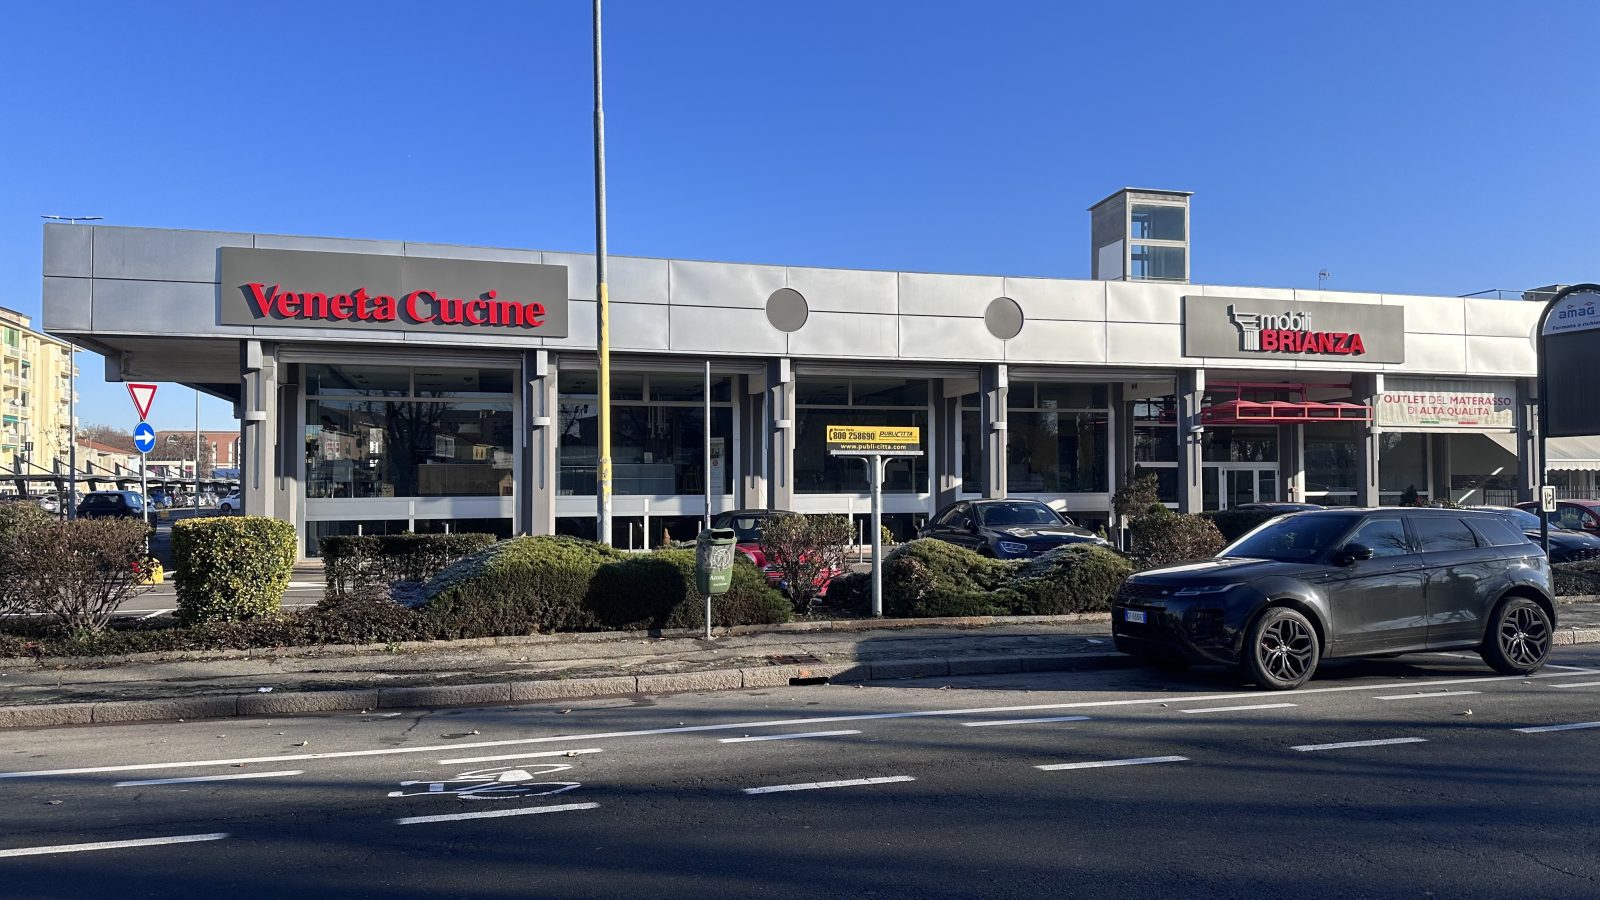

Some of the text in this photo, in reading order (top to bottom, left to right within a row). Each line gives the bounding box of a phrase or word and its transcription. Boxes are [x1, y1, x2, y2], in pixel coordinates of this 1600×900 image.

[248, 282, 546, 327] Veneta Cucine
[1260, 311, 1312, 331] mobili
[1261, 330, 1366, 355] BRIANZA
[1384, 394, 1512, 406] OUTLET DEL MATERASSO
[1407, 406, 1418, 415] DI
[1420, 406, 1445, 415] ALTA
[833, 431, 847, 440] 800
[849, 431, 875, 440] 258690
